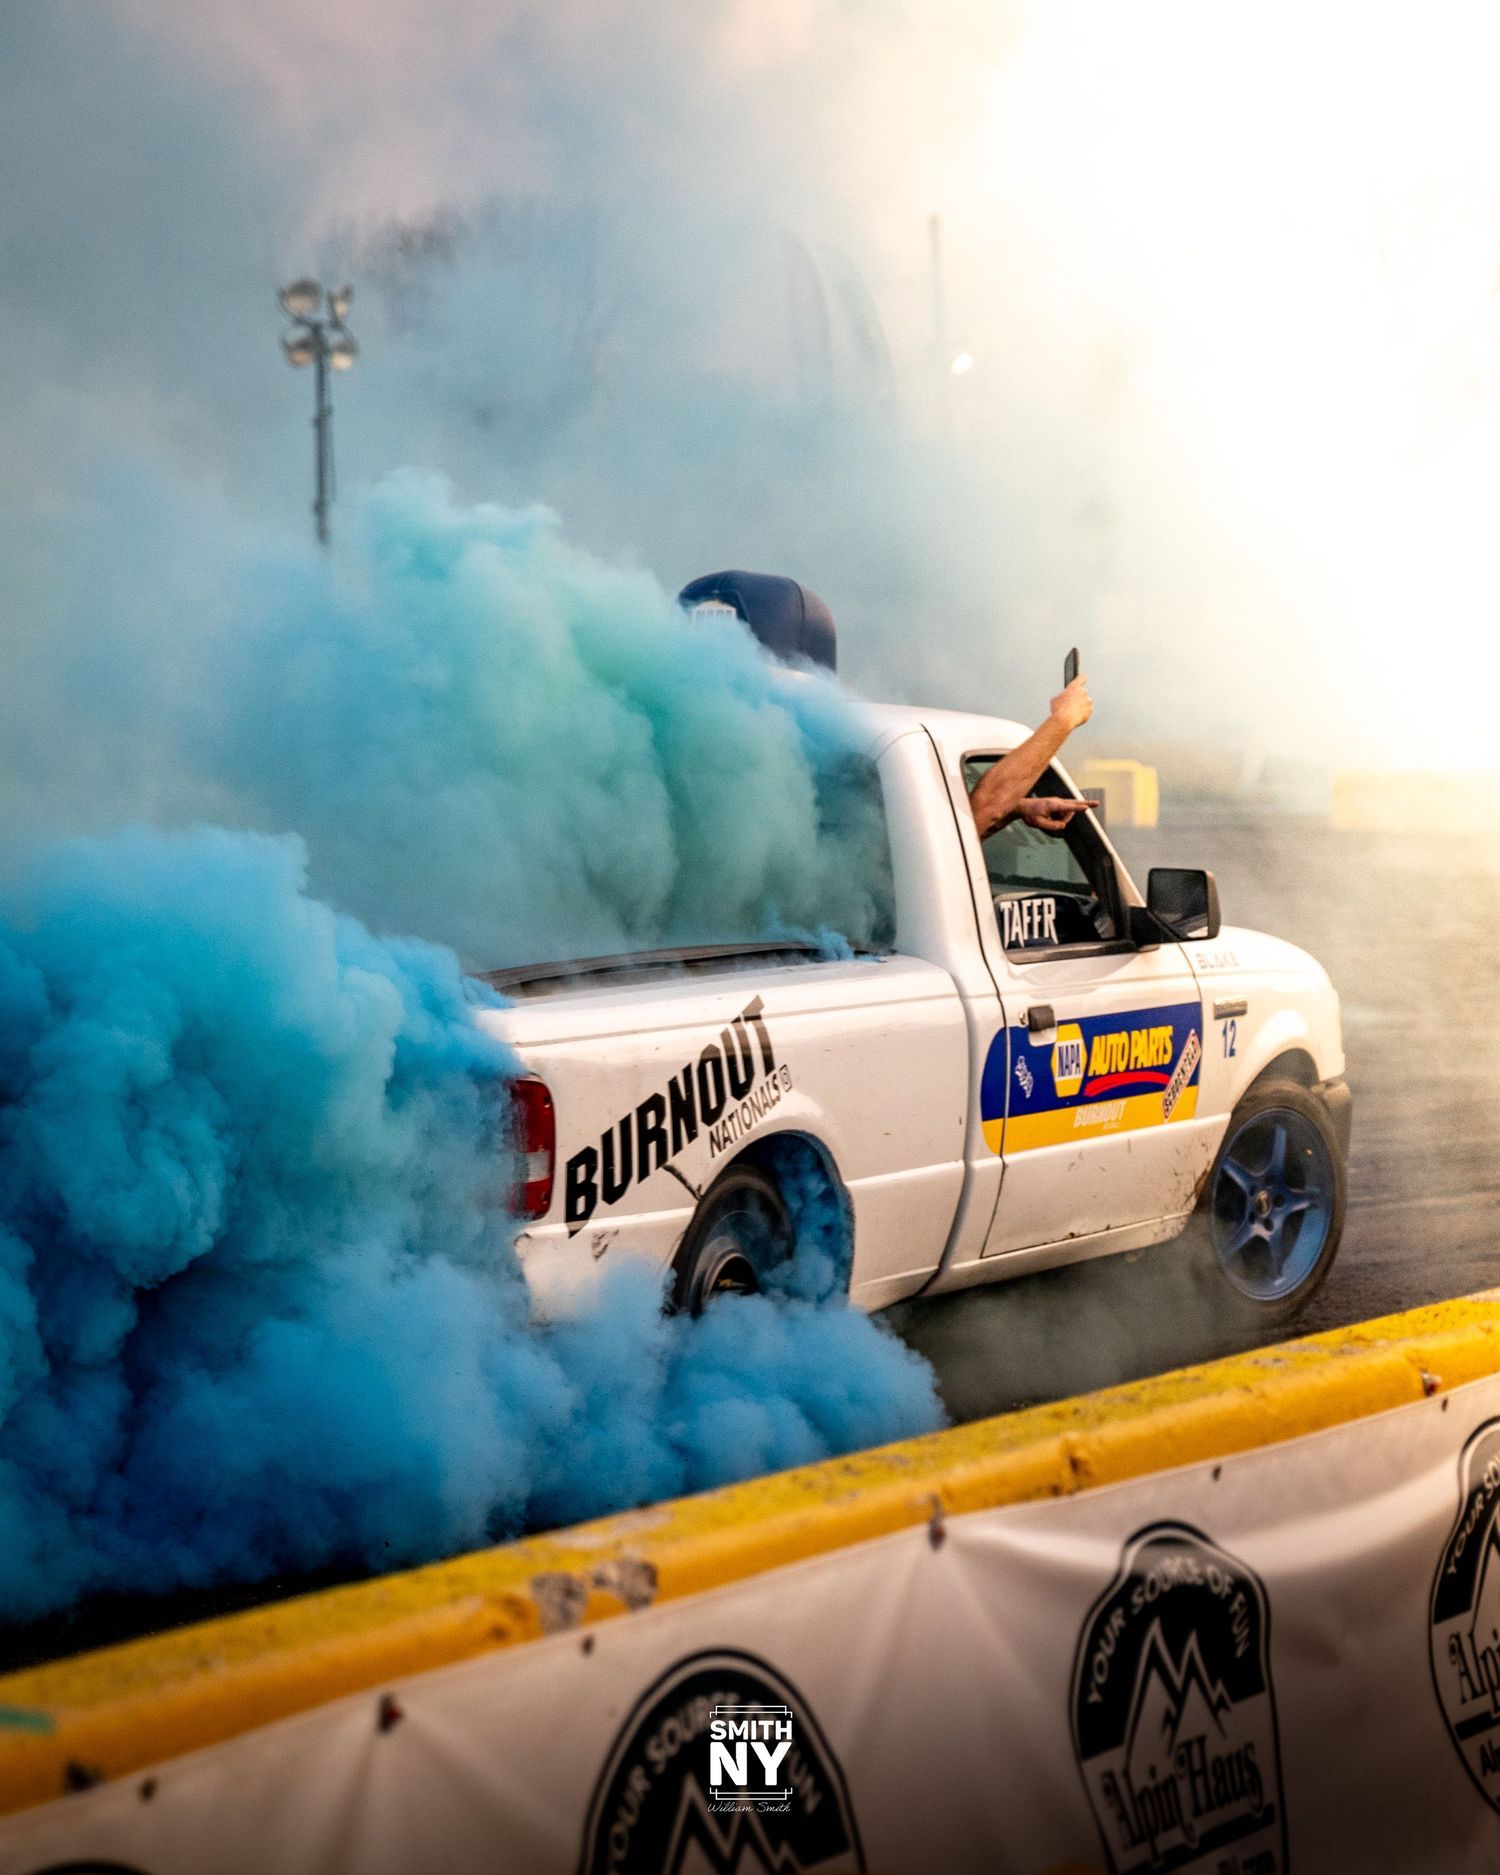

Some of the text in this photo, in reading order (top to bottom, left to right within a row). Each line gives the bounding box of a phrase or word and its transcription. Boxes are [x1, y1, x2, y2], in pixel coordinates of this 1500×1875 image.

[1000, 897, 1058, 949] TAFFR
[1057, 1043, 1081, 1078] NAPA
[1088, 1031, 1129, 1077] AUTO
[1129, 1025, 1173, 1070] PARTS
[1223, 1019, 1236, 1059] 12
[565, 994, 775, 1239] BURNOUT
[1446, 1491, 1485, 1576] YOUR
[1086, 1606, 1127, 1704] YOUR
[1208, 1565, 1237, 1600] OF
[1230, 1591, 1254, 1661] FUN
[1103, 1736, 1263, 1861] Alpin Haus
